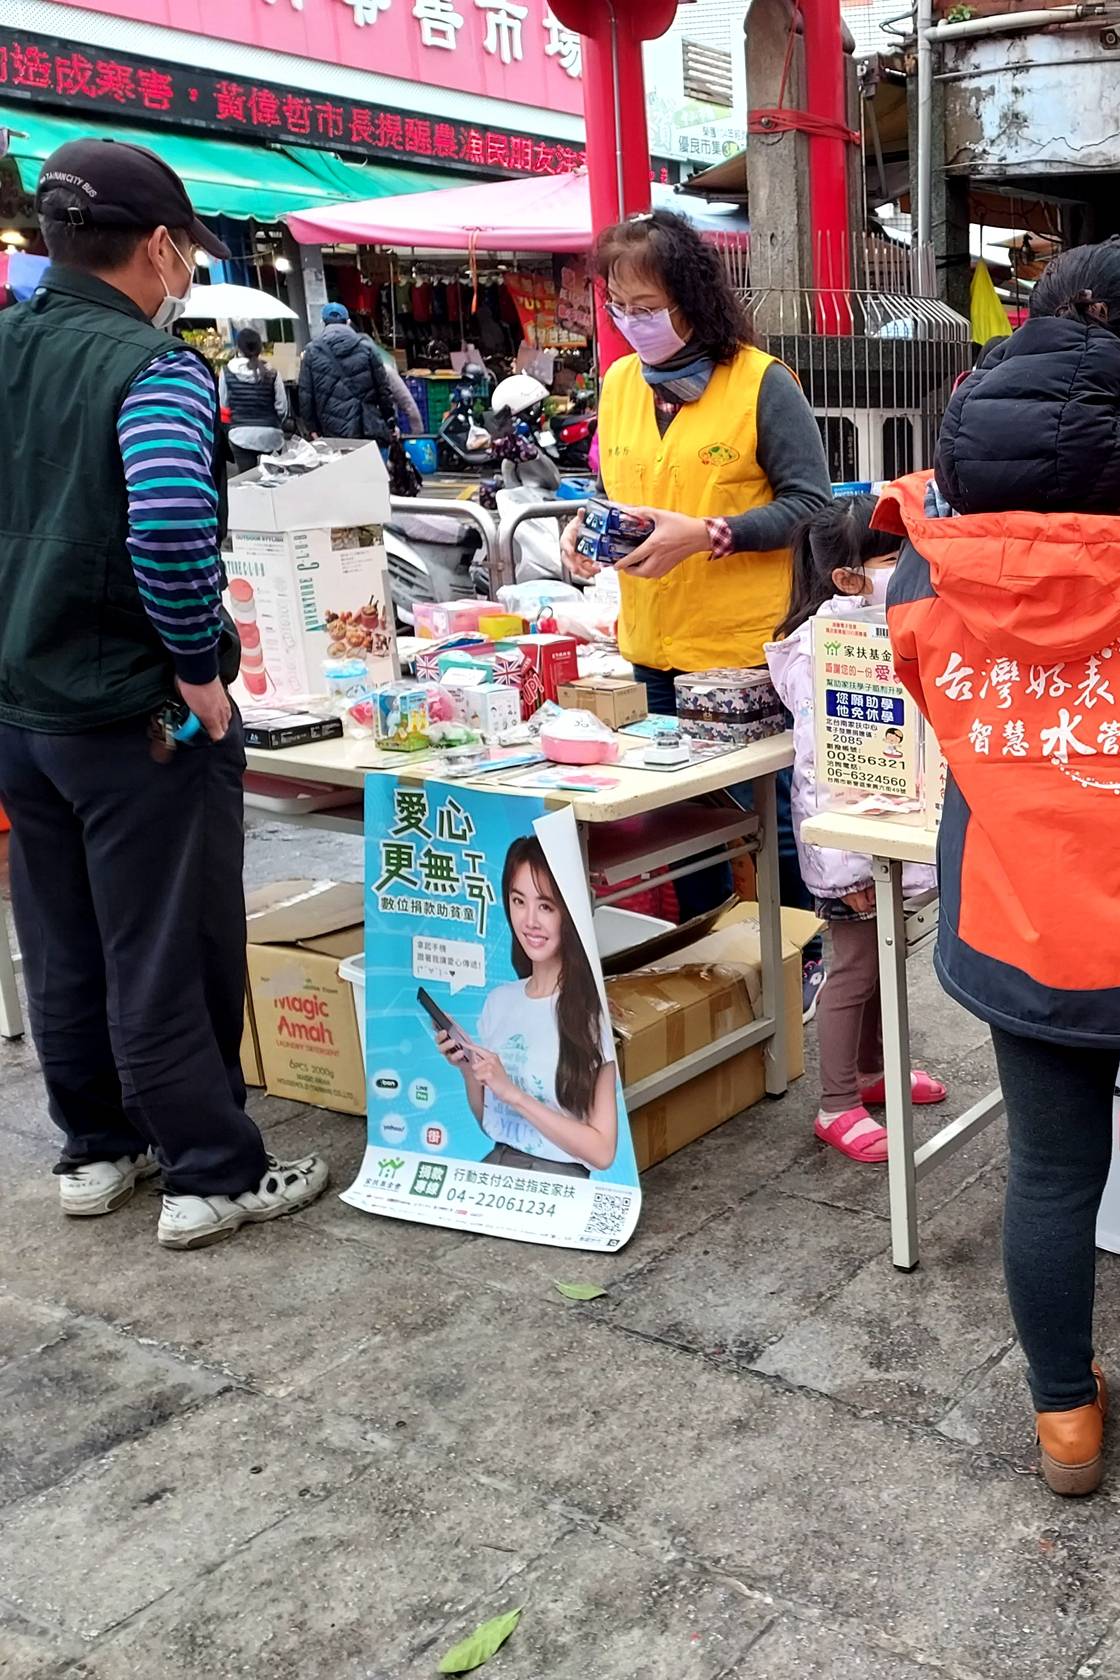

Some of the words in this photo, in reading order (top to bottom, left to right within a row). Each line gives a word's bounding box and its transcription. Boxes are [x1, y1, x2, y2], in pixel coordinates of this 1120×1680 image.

[81, 182, 97, 198] BUS
[935, 652, 1115, 708] 台灣好表
[836, 692, 893, 710] 您願助學
[836, 704, 894, 722] 他免休學
[833, 734, 863, 746] 2085
[827, 750, 905, 769] 00356321
[827, 767, 906, 787] 06-6324560
[391, 791, 473, 841] 愛心
[381, 896, 475, 921] 數位捐款助貧童
[274, 994, 329, 1020] Magic
[278, 1015, 334, 1045] Amah
[453, 1167, 576, 1199] 行動支付公益指定家扶
[446, 1187, 557, 1218] 04-22061234
